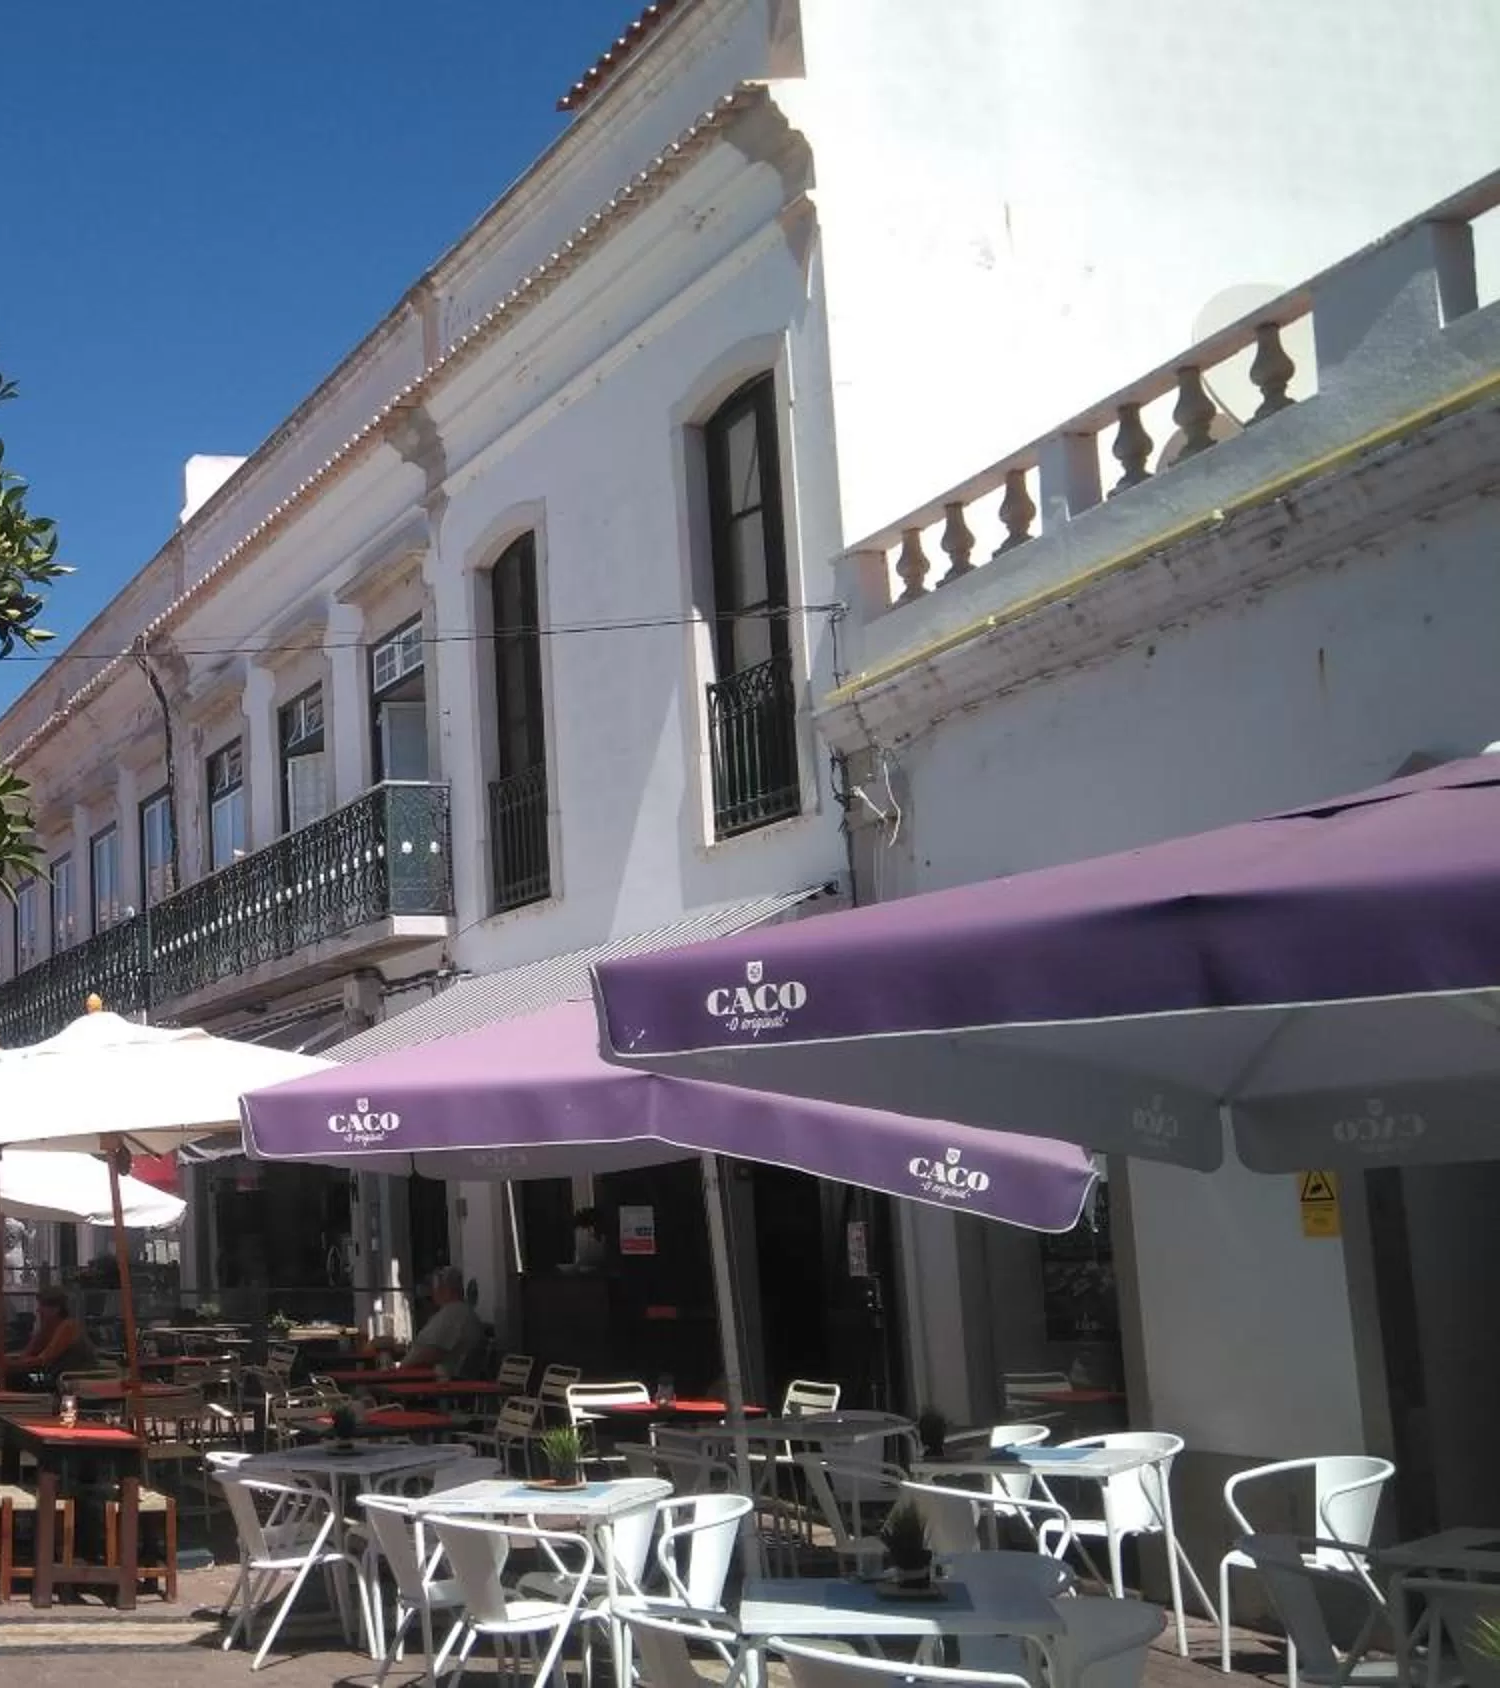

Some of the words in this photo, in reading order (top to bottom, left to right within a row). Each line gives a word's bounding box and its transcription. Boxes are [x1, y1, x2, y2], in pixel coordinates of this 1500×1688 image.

[706, 981, 807, 1016] CACO
[327, 1112, 400, 1132] CACO
[909, 1157, 989, 1191] CACO
